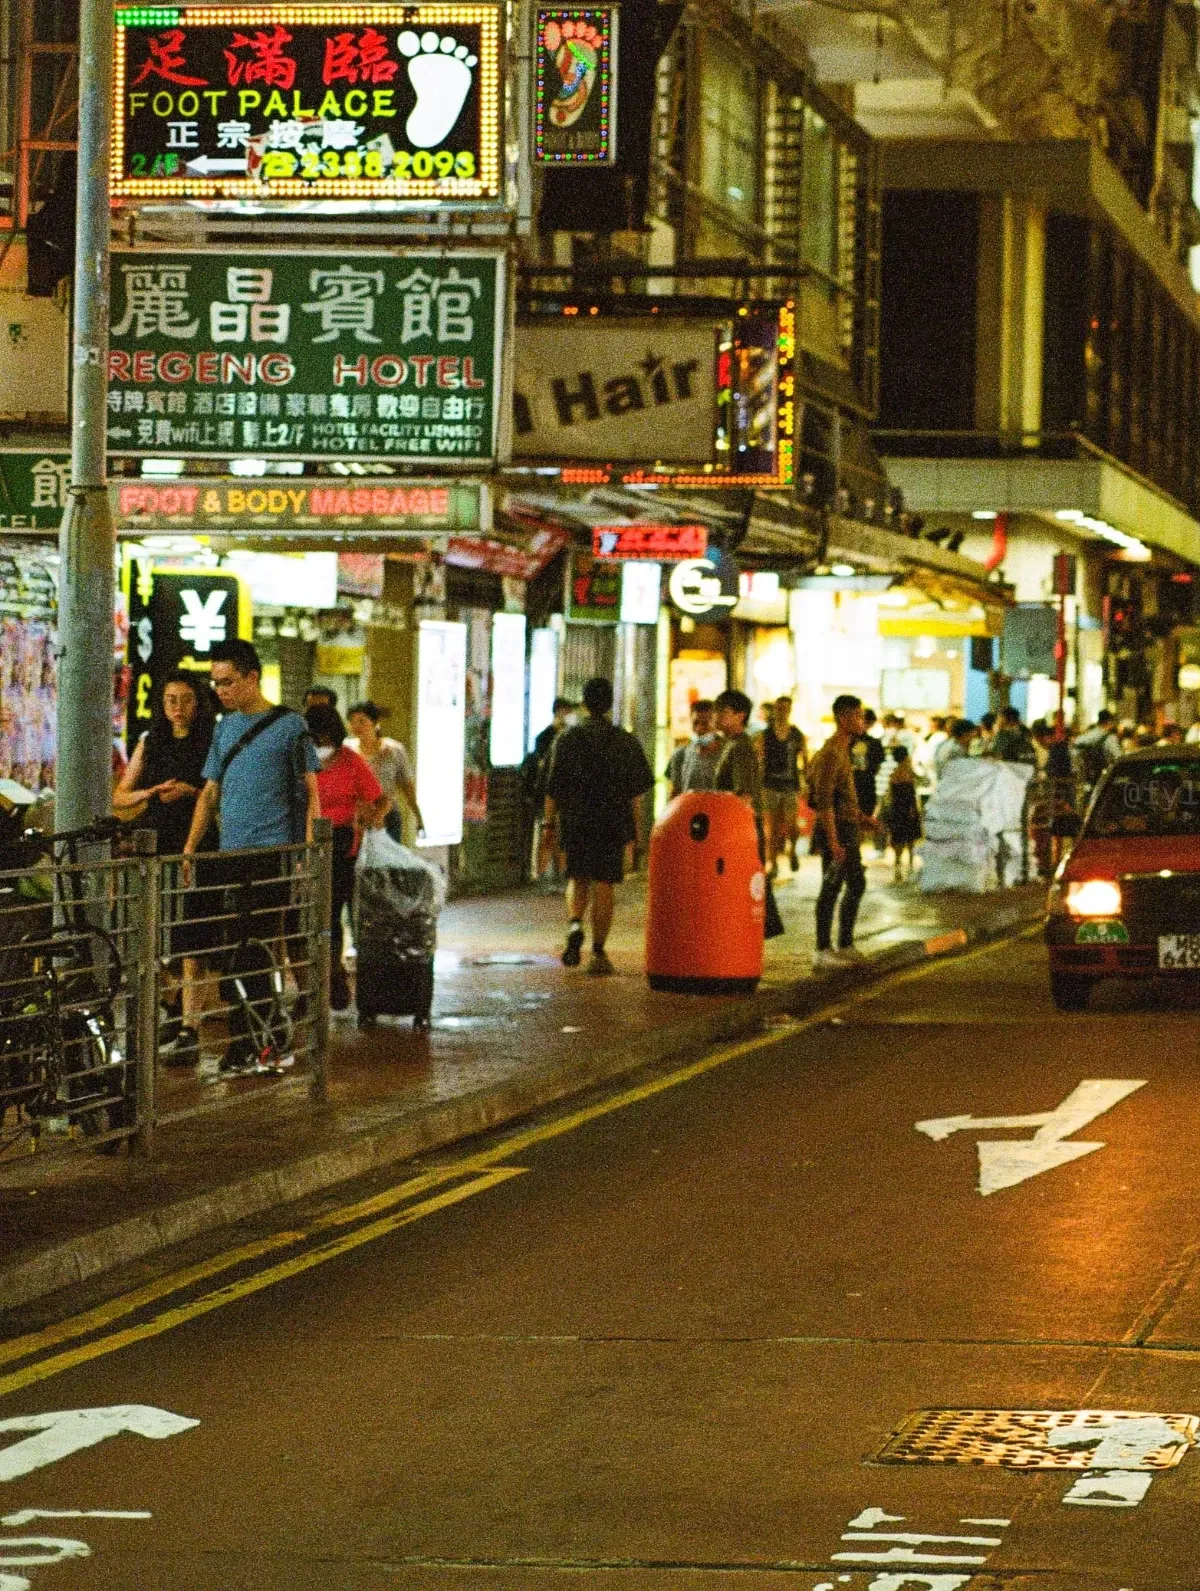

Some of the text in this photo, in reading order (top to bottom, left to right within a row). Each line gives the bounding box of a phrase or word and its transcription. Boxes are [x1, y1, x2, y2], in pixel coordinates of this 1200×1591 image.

[132, 25, 399, 89] 足滿臨
[129, 90, 398, 117] FOOT PALACE
[393, 151, 476, 178] 2093
[111, 264, 482, 344] 麗晶賓館
[106, 350, 485, 389] REGENG HOTEL
[552, 352, 699, 427] Hair
[311, 437, 482, 452] HOTEL FREE WIFI
[118, 486, 449, 516] FOOT & BODY MASSAGE
